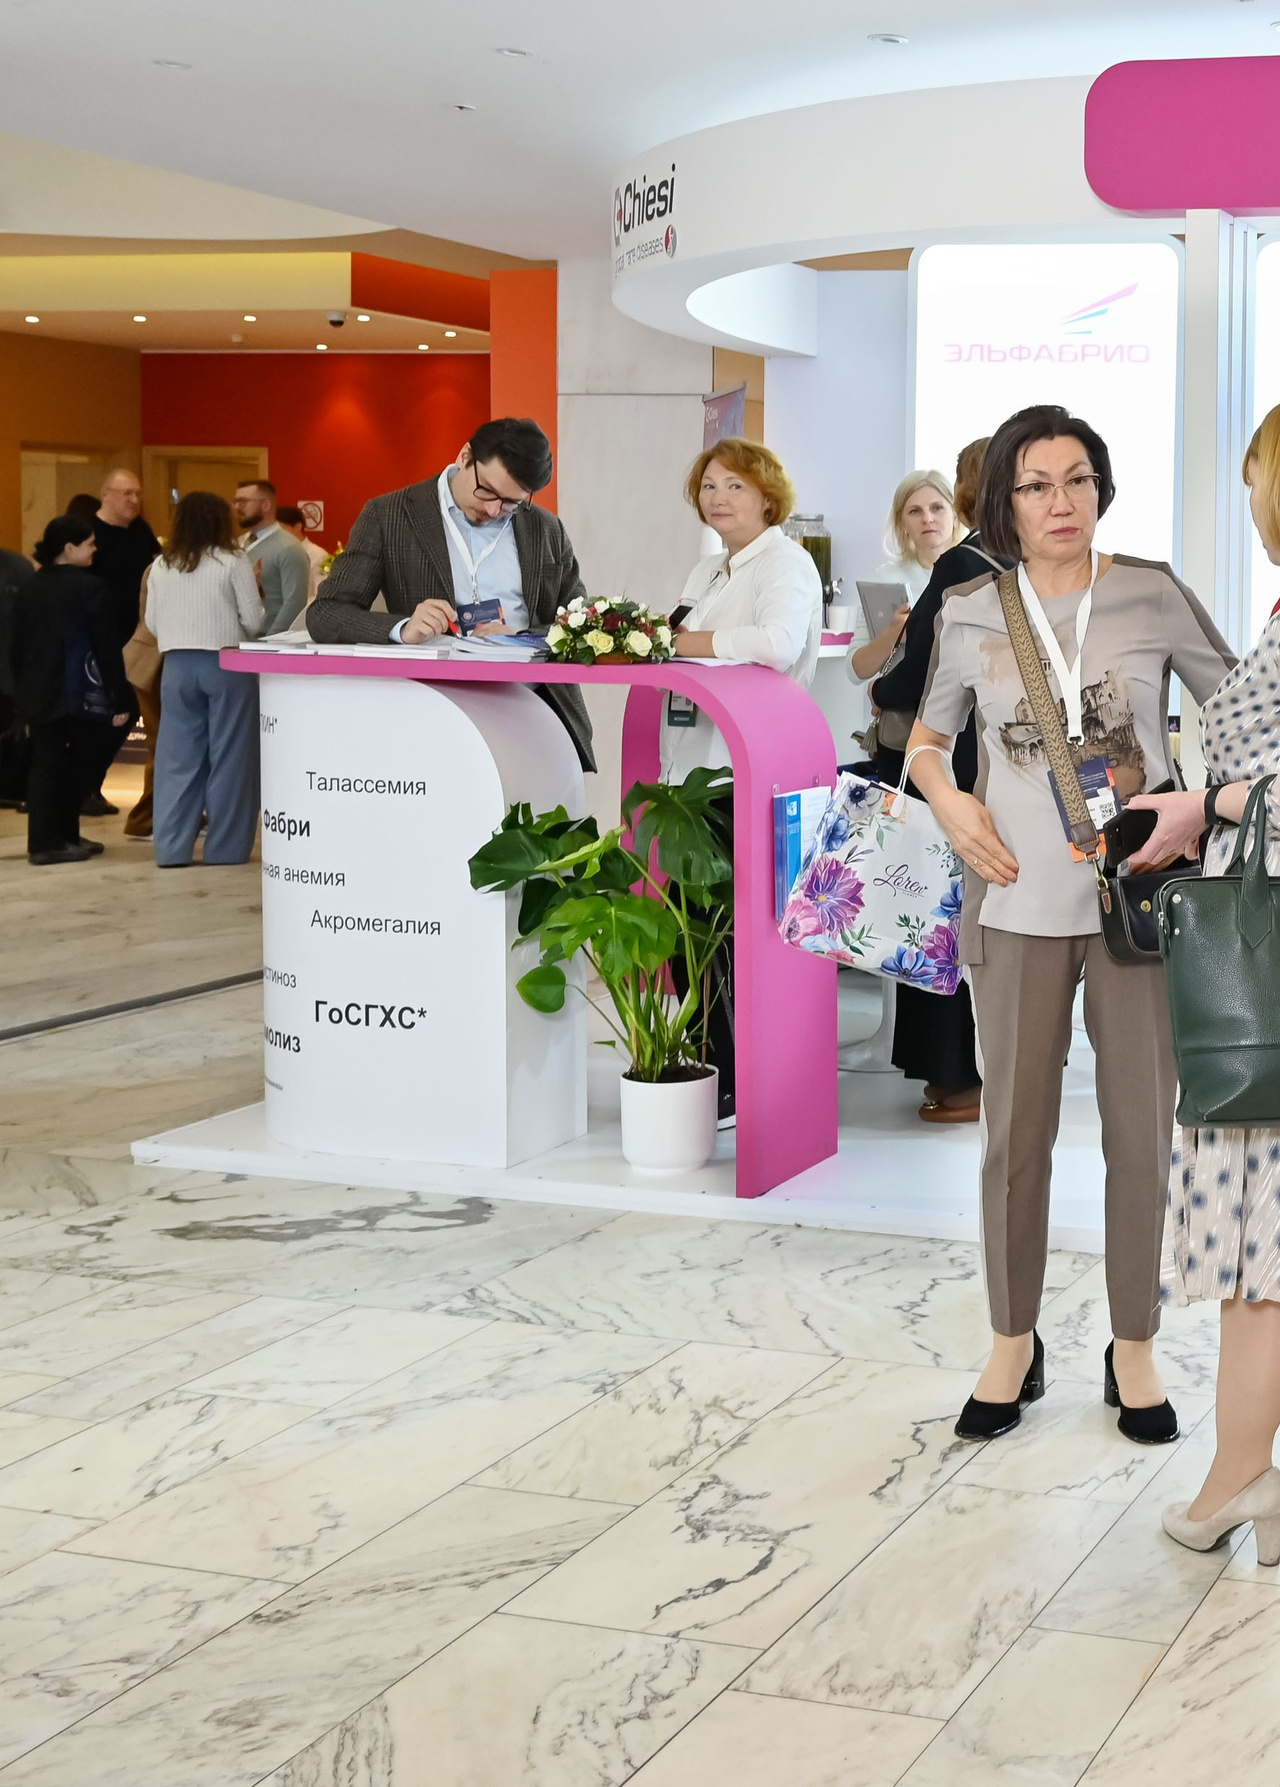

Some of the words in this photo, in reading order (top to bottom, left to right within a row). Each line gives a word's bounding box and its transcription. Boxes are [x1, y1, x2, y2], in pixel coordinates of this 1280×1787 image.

[623, 163, 676, 233] Chiesi
[943, 344, 1150, 363] ЭЛЬФАБРИО
[305, 771, 427, 797] Талассемия
[263, 808, 311, 841] Фабри
[284, 867, 346, 887] анемия
[310, 909, 442, 936] Акромегалия
[265, 966, 297, 989] стиноз
